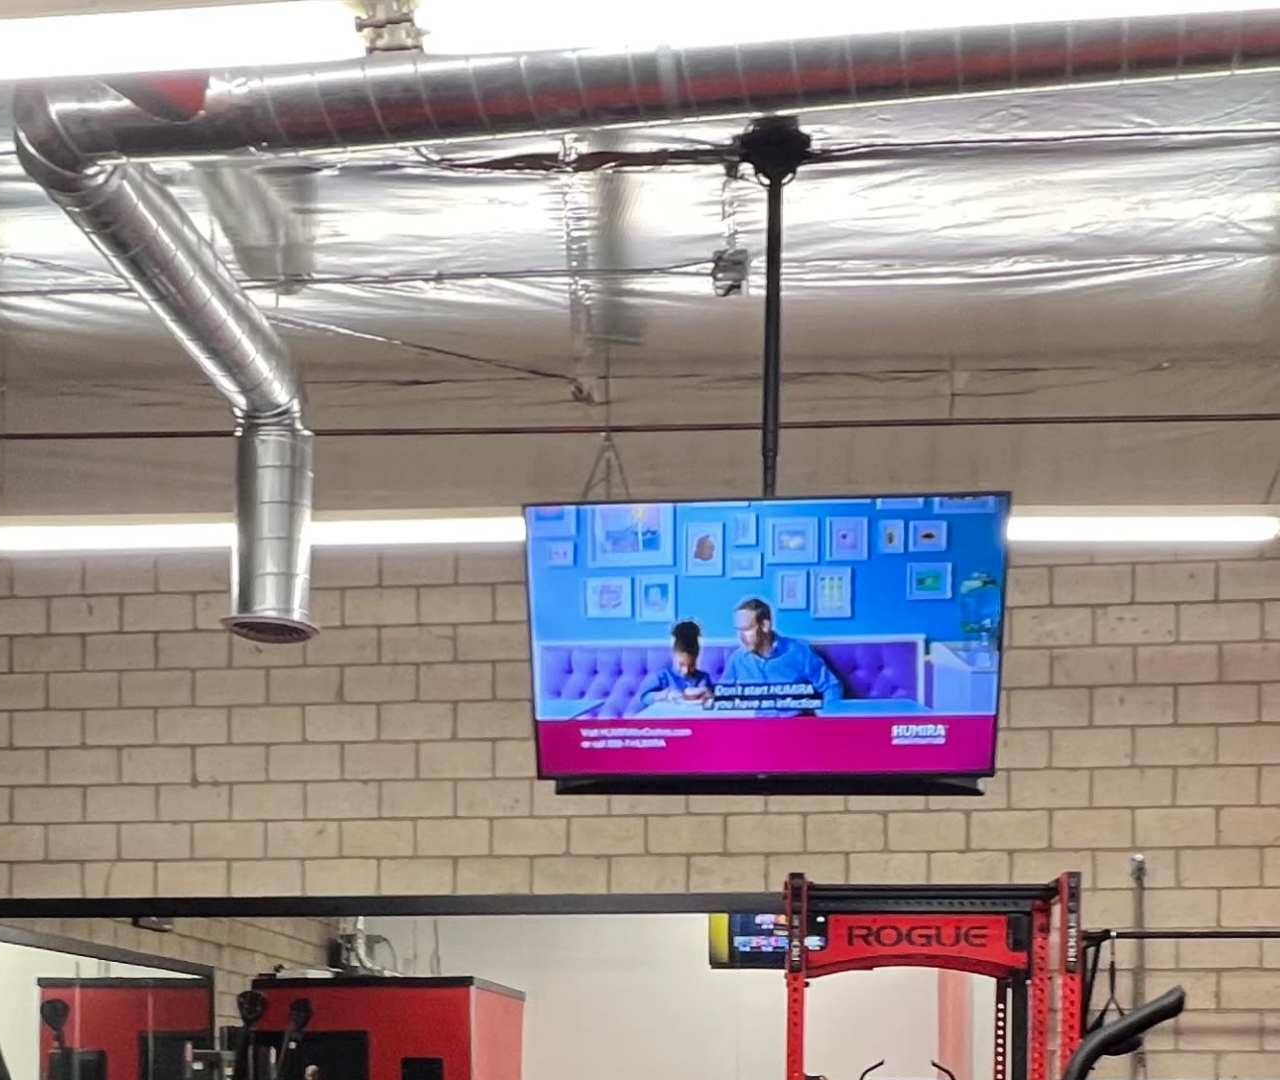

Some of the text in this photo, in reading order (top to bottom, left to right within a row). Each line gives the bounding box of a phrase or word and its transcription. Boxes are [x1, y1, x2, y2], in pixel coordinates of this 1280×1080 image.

[769, 683, 815, 696] HUMIRA
[891, 724, 946, 737] HUMIRA
[847, 925, 988, 947] ROGUE
